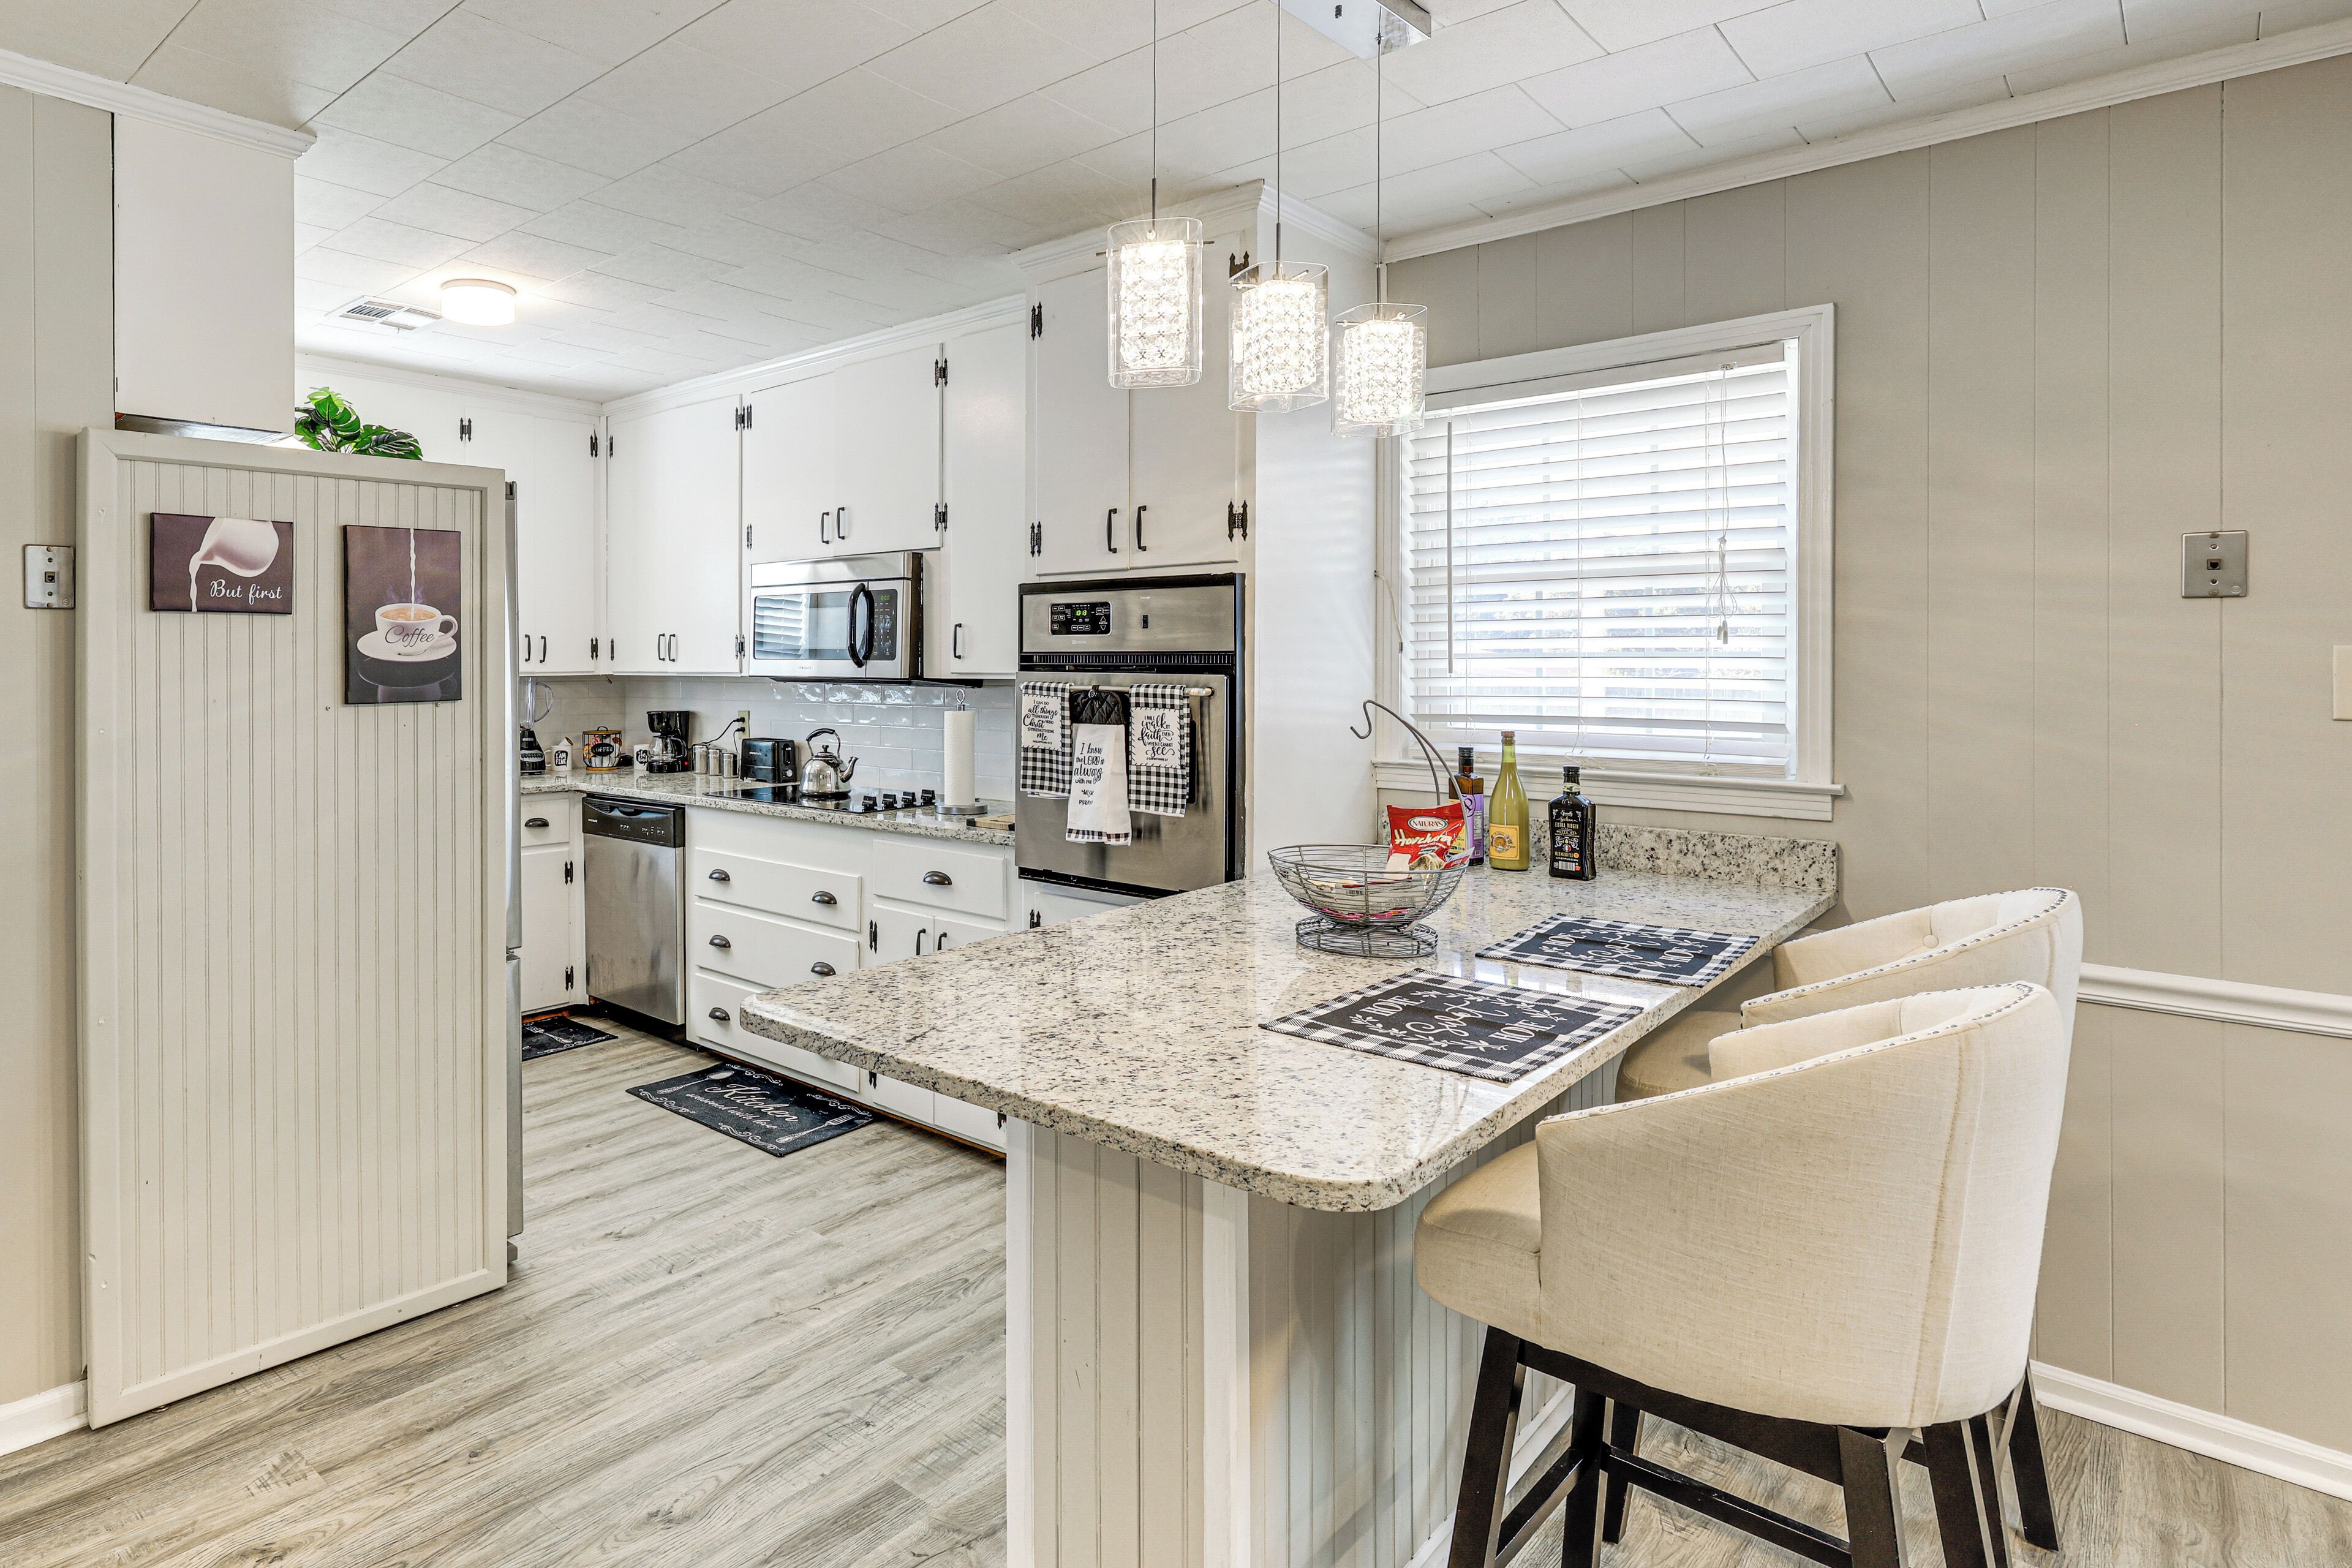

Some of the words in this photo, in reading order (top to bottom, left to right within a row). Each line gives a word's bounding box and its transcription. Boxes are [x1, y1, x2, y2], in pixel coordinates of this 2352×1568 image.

[210, 579, 243, 598] But
[249, 583, 282, 605] first
[385, 625, 435, 647] Coffee
[1023, 713, 1045, 728] Christ
[1028, 704, 1039, 714] all
[1039, 706, 1058, 720] things
[1141, 712, 1166, 730] walk
[1137, 727, 1172, 746] faith
[1080, 742, 1085, 755] I
[1087, 743, 1103, 755] know
[1084, 755, 1100, 766] LORD
[1074, 763, 1103, 784] always
[1393, 829, 1453, 847] Horchata
[685, 1093, 738, 1111] seasoned
[728, 1106, 760, 1120] with
[752, 1119, 778, 1129] love
[704, 1084, 799, 1122] Kitchen
